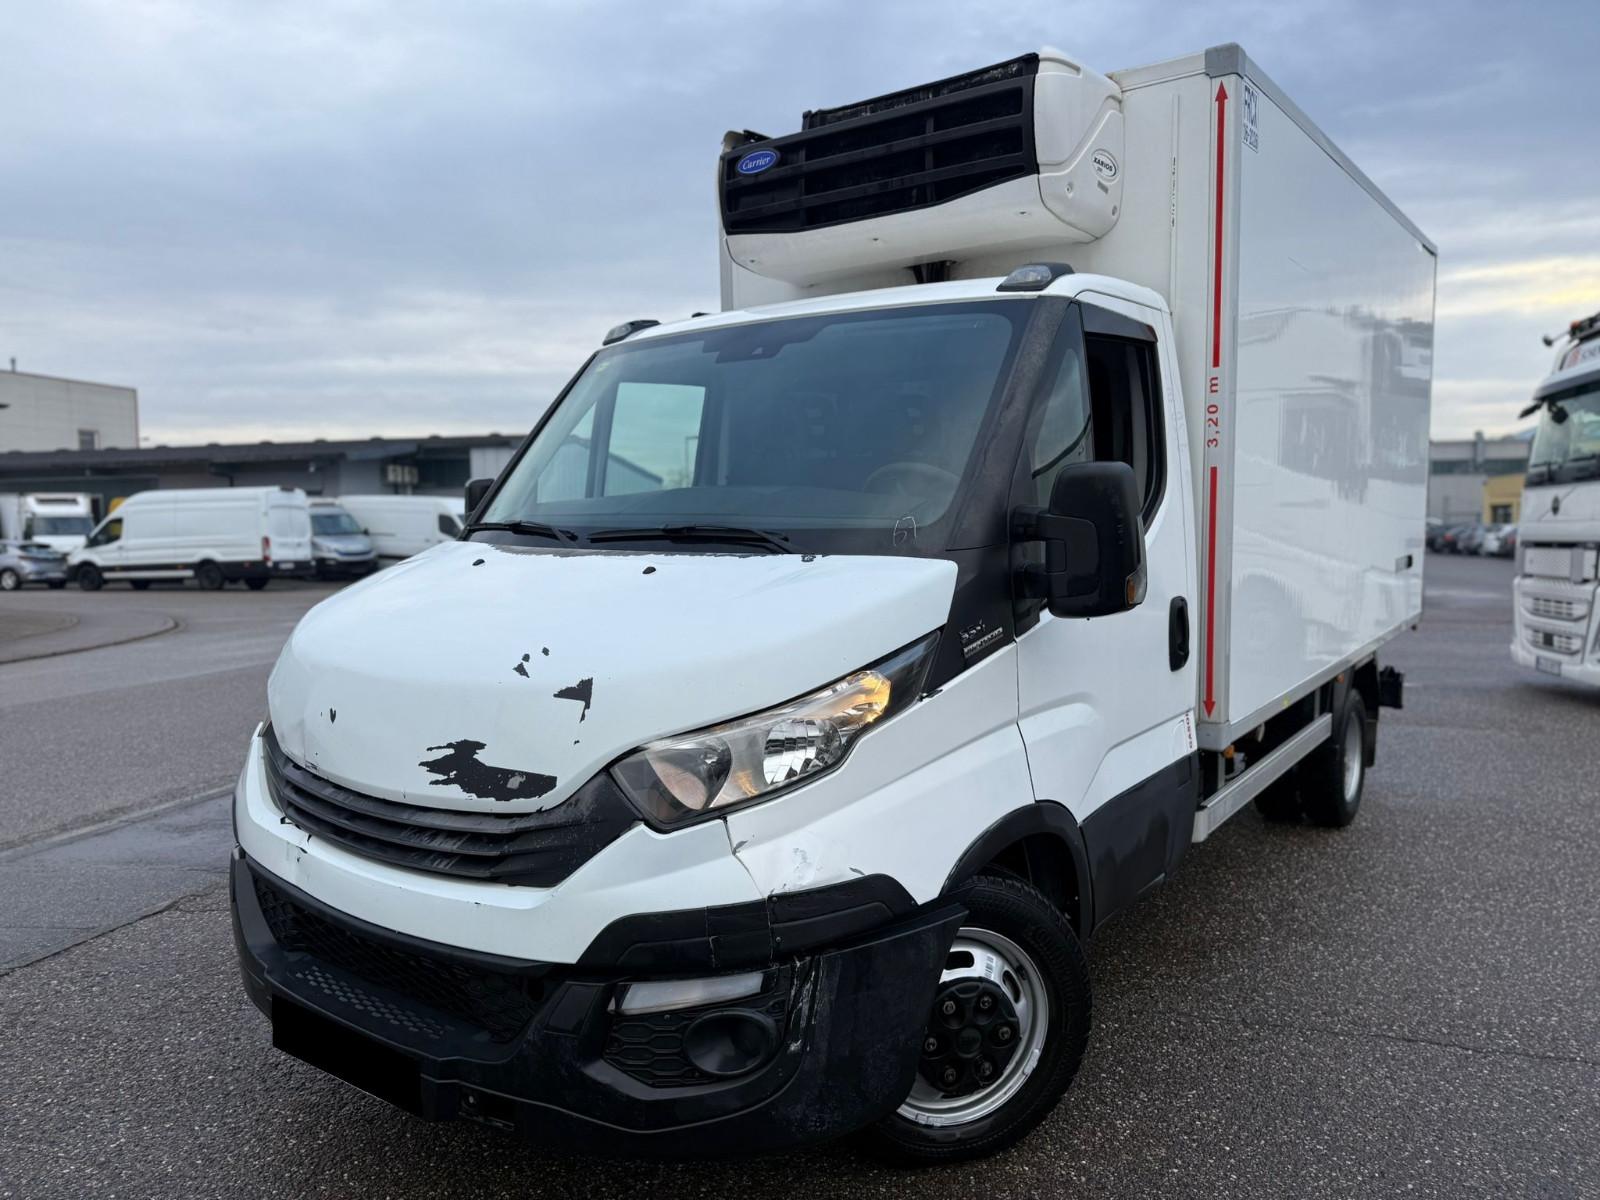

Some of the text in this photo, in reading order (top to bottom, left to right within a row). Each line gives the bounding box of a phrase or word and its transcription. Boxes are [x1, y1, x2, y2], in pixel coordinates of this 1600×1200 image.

[742, 156, 771, 170] Carrier
[1093, 156, 1113, 172] XARIOS
[1207, 376, 1220, 448] 3,20 m
